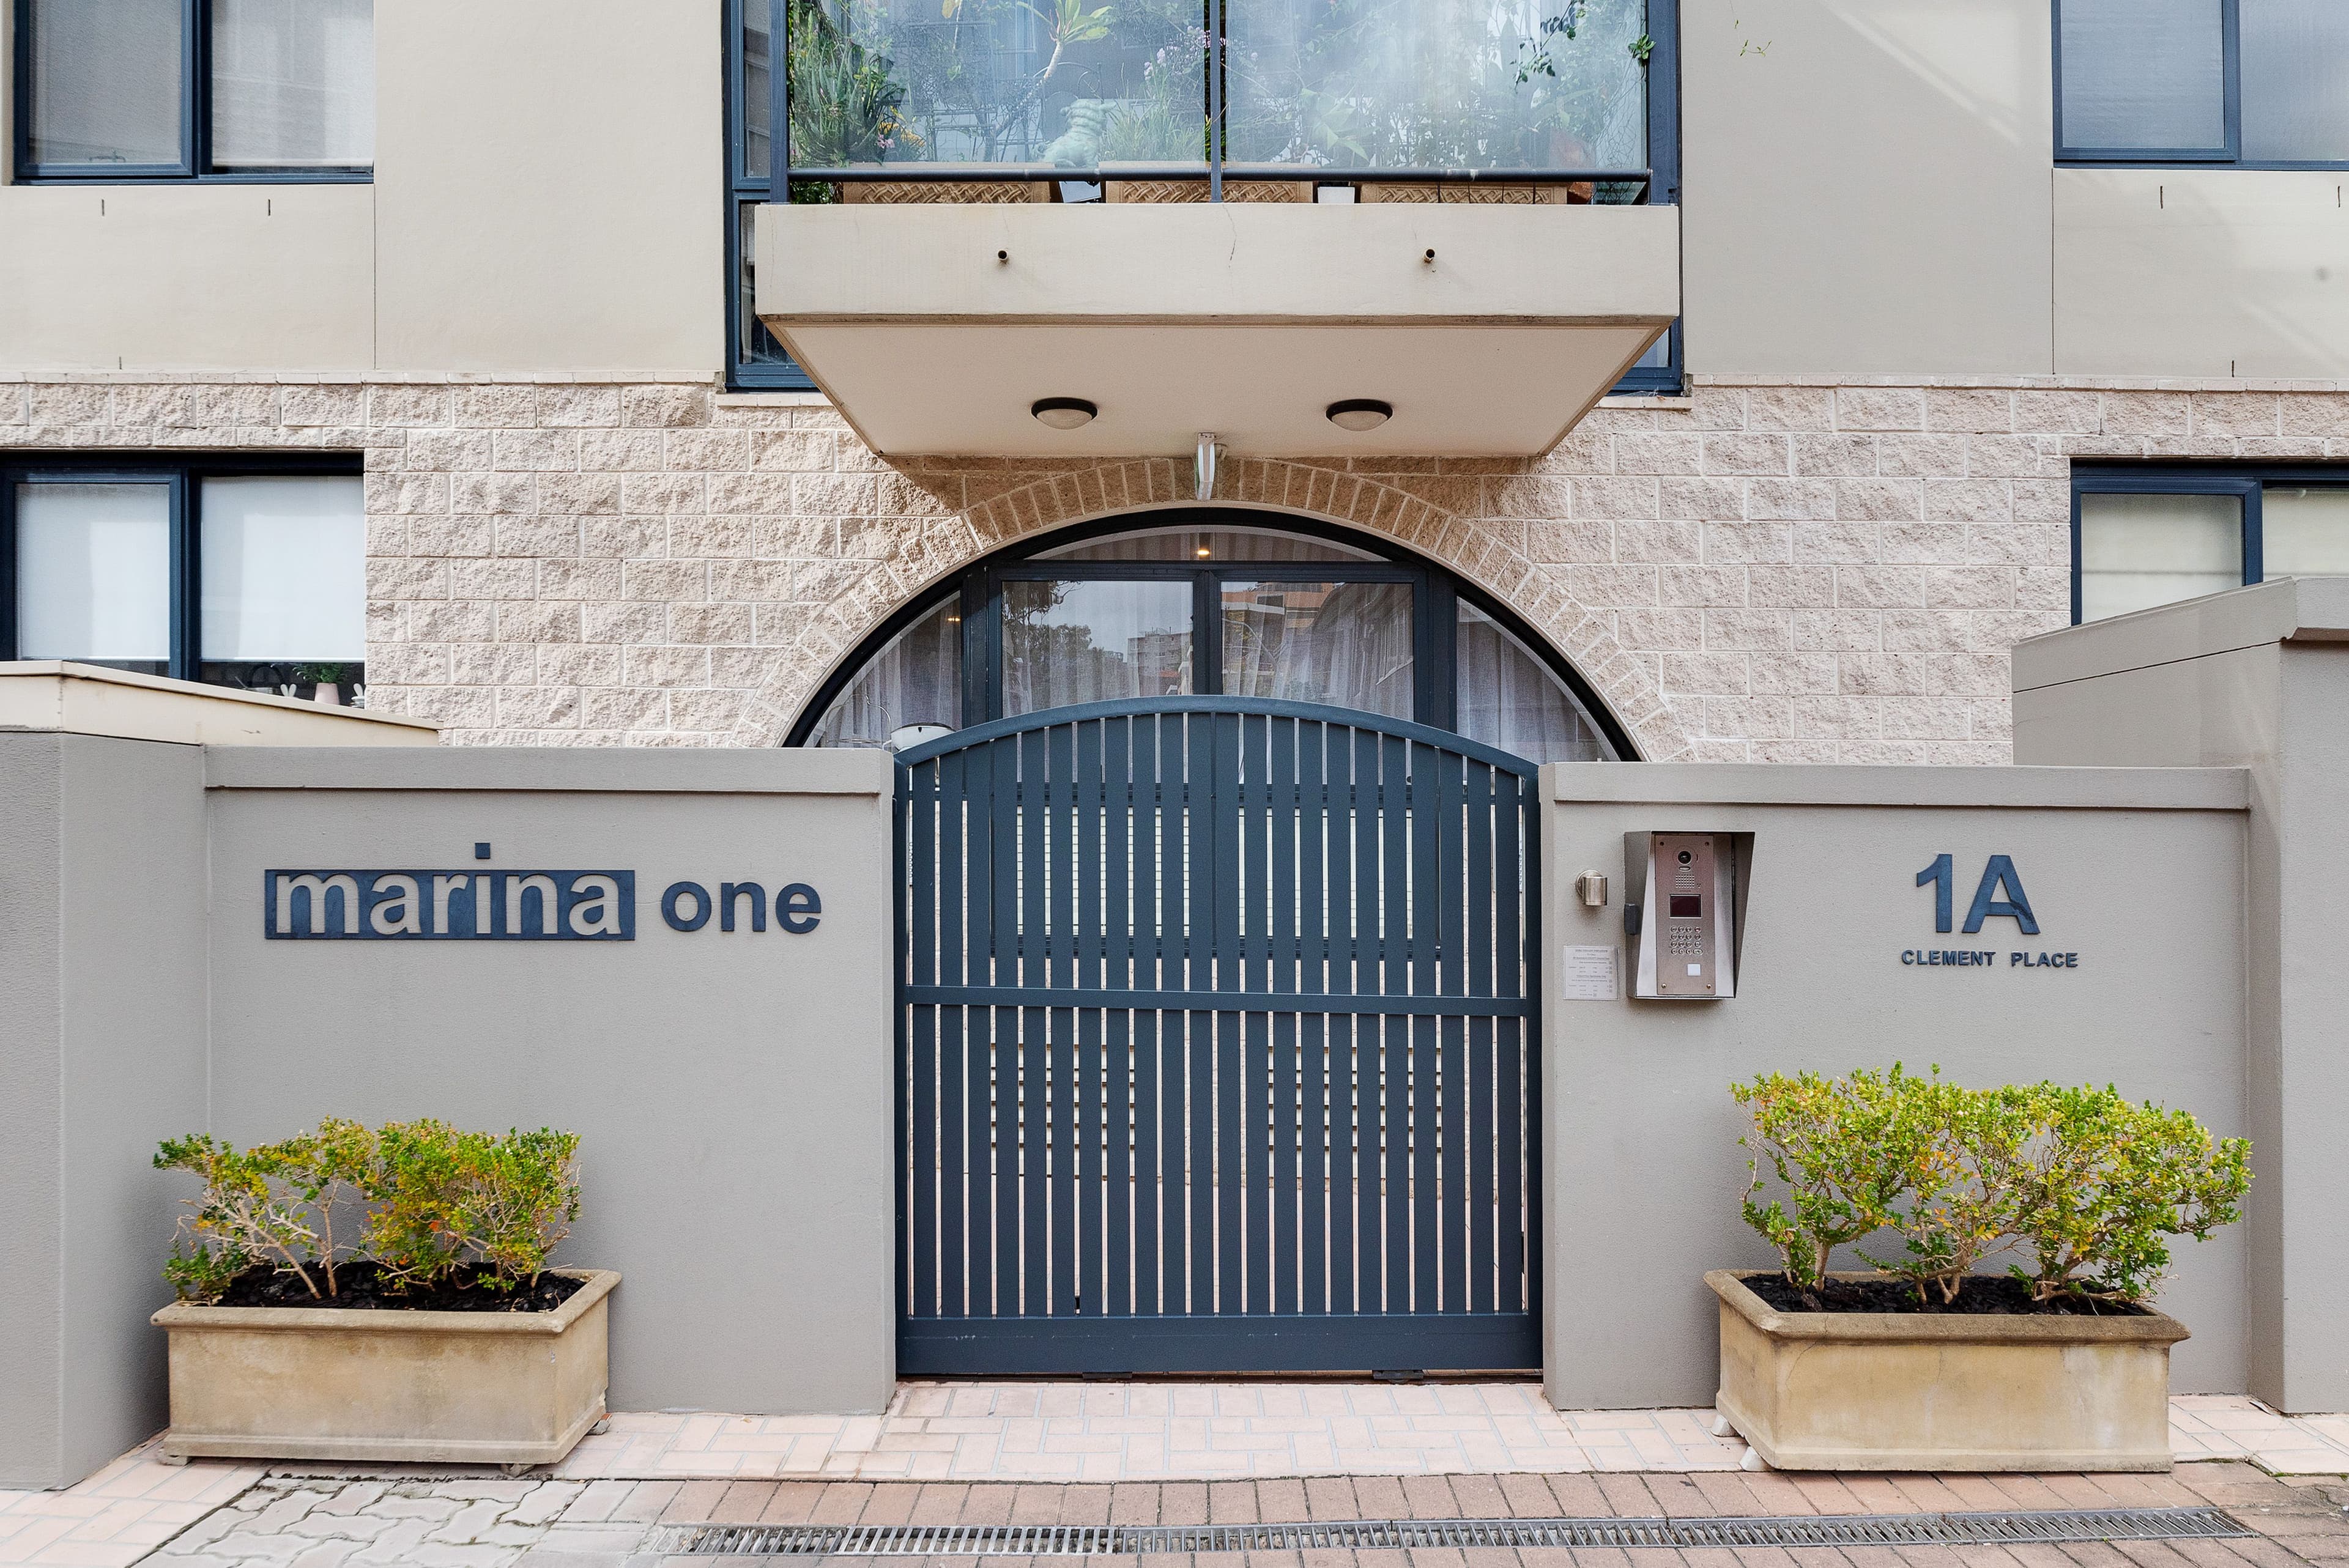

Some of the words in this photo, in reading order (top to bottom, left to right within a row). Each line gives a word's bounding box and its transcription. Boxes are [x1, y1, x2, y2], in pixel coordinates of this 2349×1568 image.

[273, 841, 623, 936] marina
[661, 881, 822, 934] one
[1916, 853, 2041, 934] 1A
[1901, 949, 1997, 967] CLEMENT
[2011, 952, 2079, 968] PLACE
